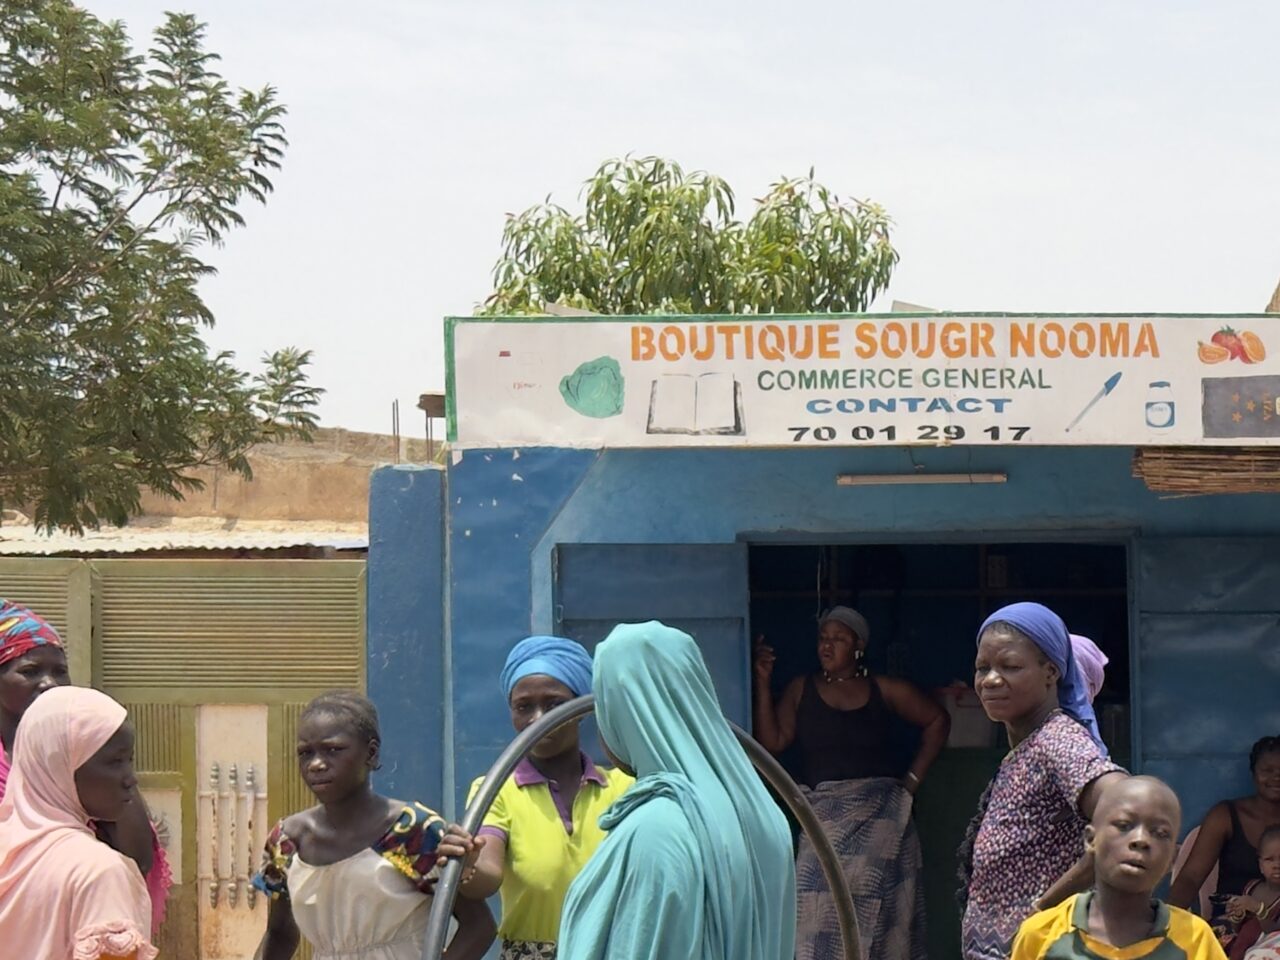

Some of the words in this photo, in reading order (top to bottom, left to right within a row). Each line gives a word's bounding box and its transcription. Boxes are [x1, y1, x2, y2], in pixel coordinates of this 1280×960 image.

[631, 324, 840, 362] BOUTIQUE
[854, 322, 996, 359] SOUGR
[1010, 322, 1160, 359] NOOMA
[757, 368, 912, 391] COMMERCE
[922, 368, 1052, 389] GENERAL
[806, 397, 1014, 414] CONTACT
[787, 426, 837, 442] 70
[851, 425, 896, 441] 01
[917, 424, 966, 441] 29
[983, 425, 1031, 441] 17
